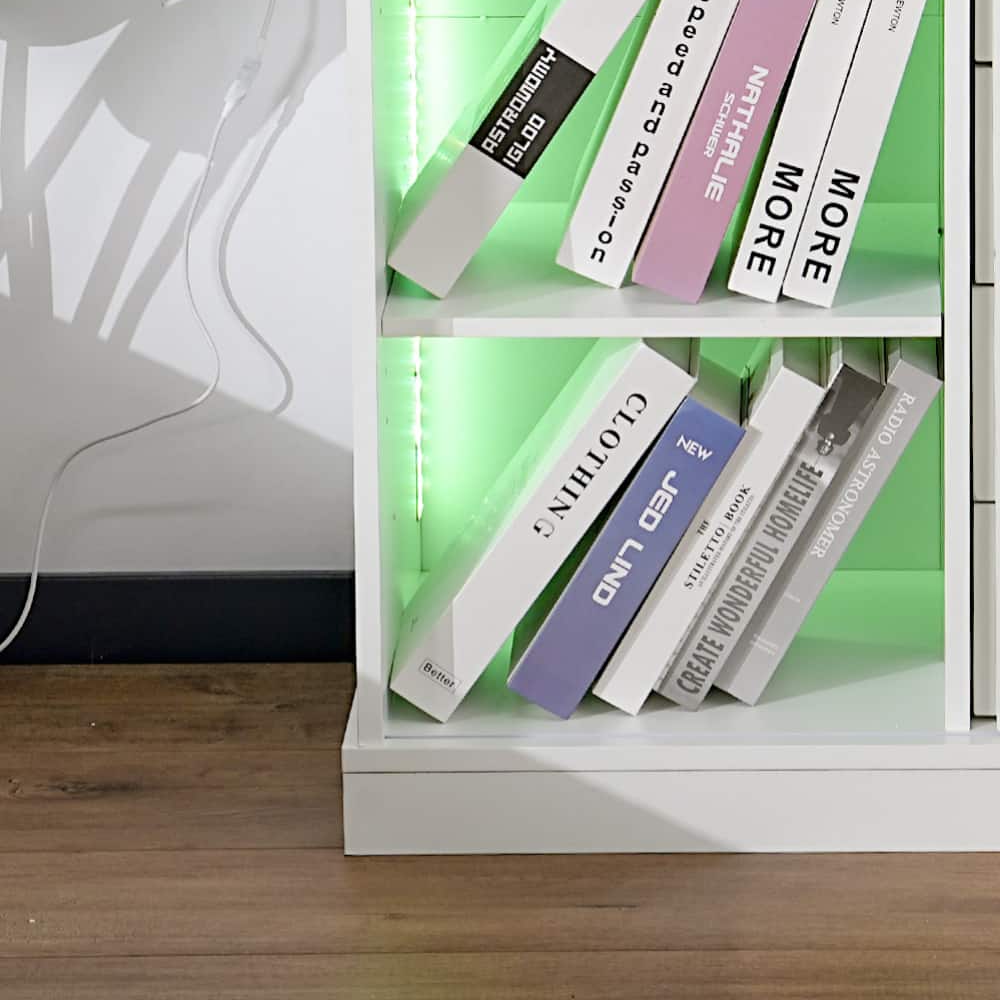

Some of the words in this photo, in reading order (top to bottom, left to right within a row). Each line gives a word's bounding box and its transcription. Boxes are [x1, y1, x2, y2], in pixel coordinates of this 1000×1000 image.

[481, 47, 556, 154] ASTRONOMY
[503, 113, 546, 167] IGLOO
[643, 83, 673, 134] and
[704, 92, 735, 158] SCHWER
[704, 64, 769, 202] NATHALIE
[590, 142, 649, 263] passion
[746, 161, 804, 276] MORE
[802, 168, 861, 284] MORE
[533, 393, 648, 538] CLOTHING
[676, 434, 713, 461] NEW
[878, 392, 916, 445] RADIO
[638, 469, 679, 532] JED
[684, 527, 725, 590] STILETTO
[724, 484, 751, 520] BOOK
[696, 519, 710, 536] THE
[810, 447, 881, 558] ASTRONOMER
[676, 635, 724, 695] CREATE
[707, 542, 779, 637] WONDERFUL
[762, 461, 824, 543] HOMELIFE
